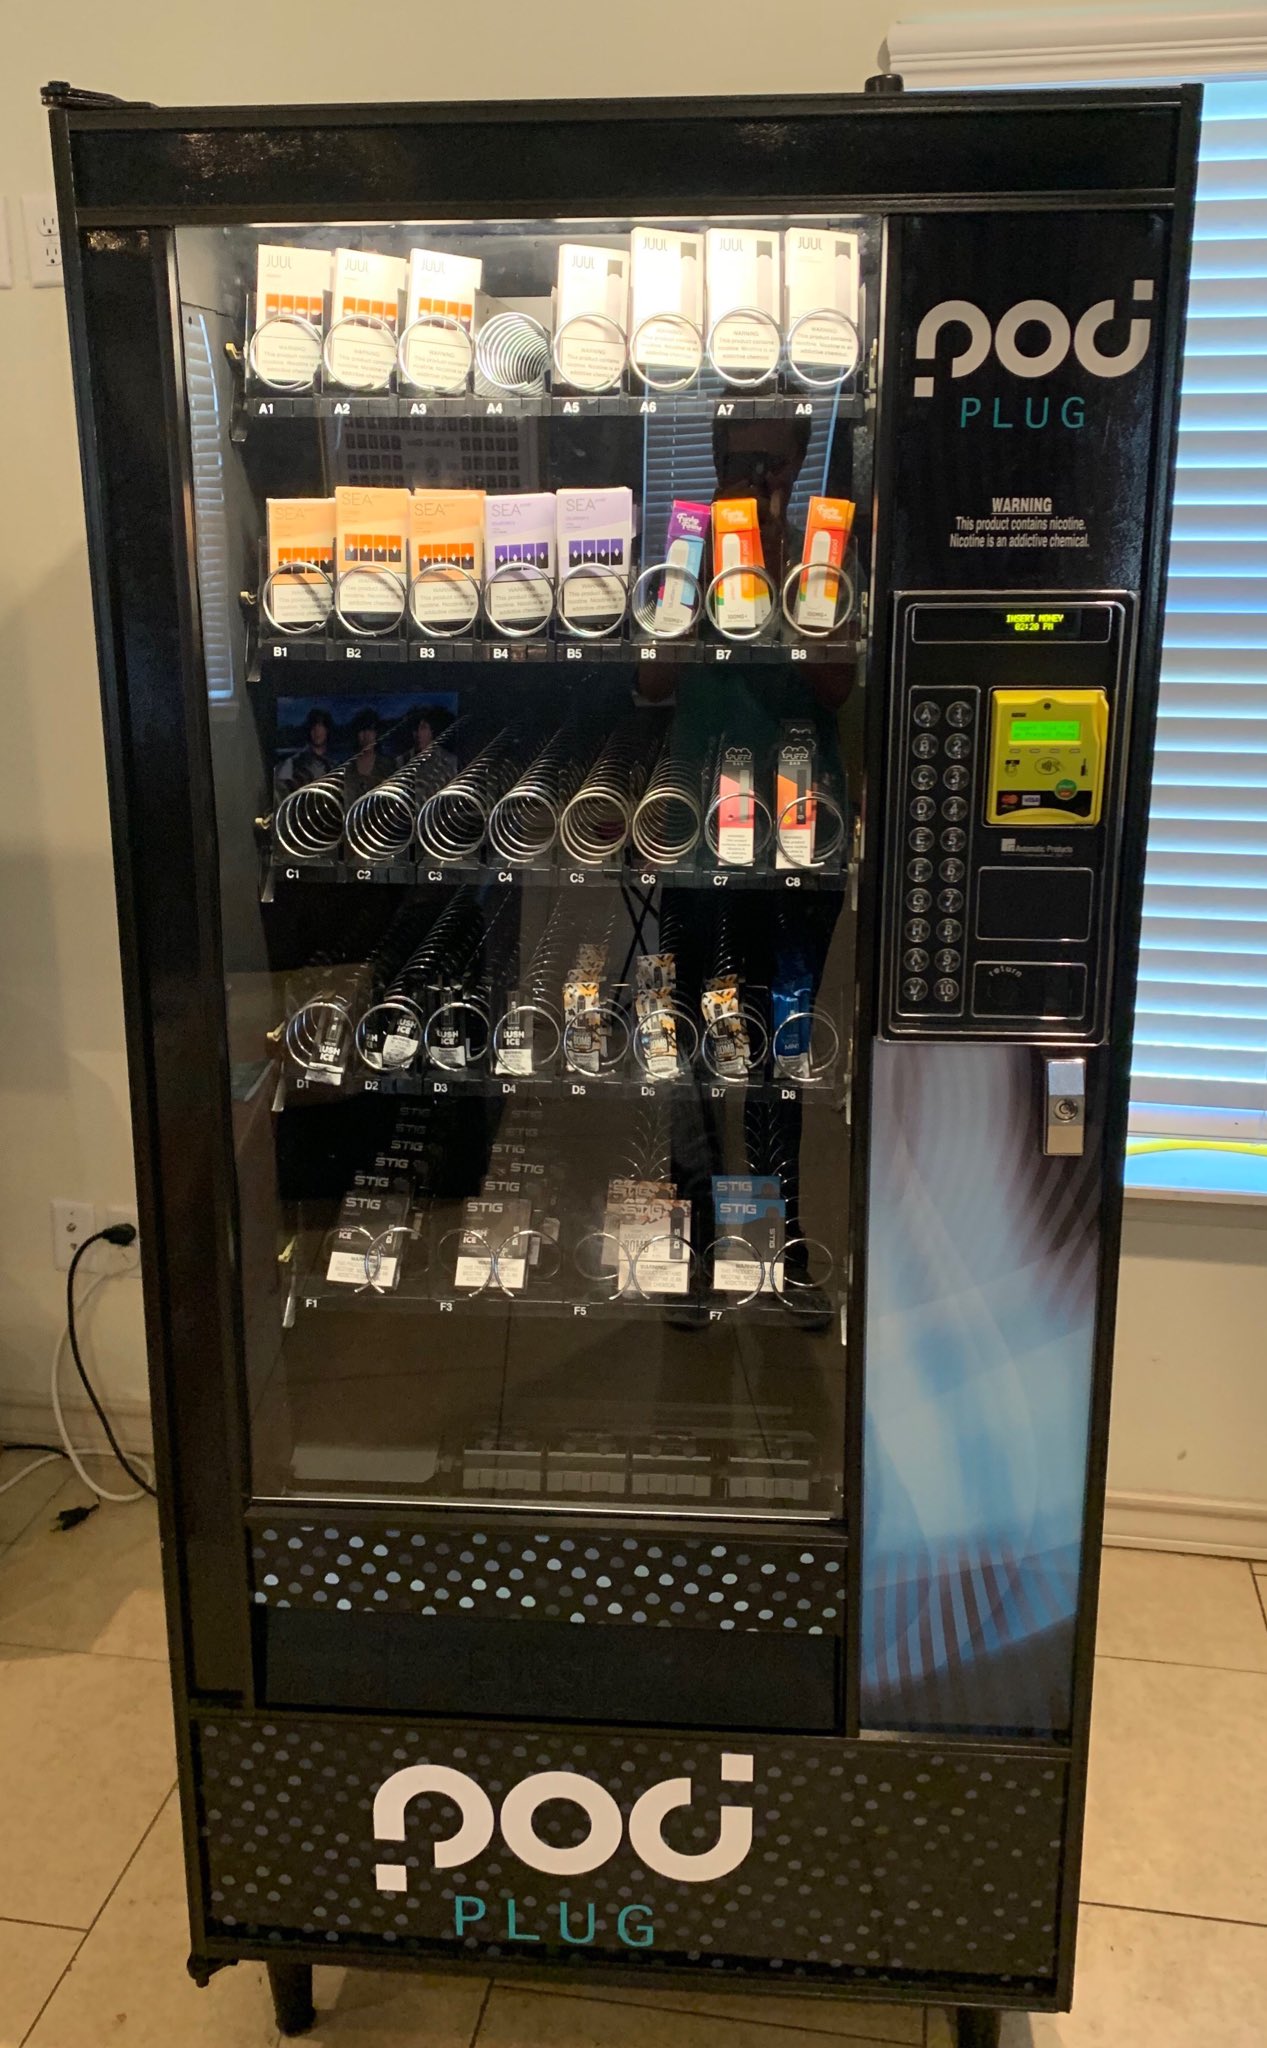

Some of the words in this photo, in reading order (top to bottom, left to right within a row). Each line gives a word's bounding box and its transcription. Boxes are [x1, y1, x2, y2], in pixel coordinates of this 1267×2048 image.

[643, 237, 668, 252] JUUL
[719, 237, 744, 253] JUUL
[797, 236, 822, 251] JUUL
[266, 255, 292, 269] JUUL
[345, 259, 368, 273] JUUL
[421, 259, 446, 274] JUUL
[571, 255, 595, 270] JUUL
[259, 403, 274, 414] A1
[334, 403, 350, 414] A2
[410, 403, 427, 415] A3
[486, 403, 503, 414] A4
[563, 402, 580, 413] A5
[640, 401, 657, 413] A6
[717, 404, 734, 415] A7
[795, 403, 813, 414] A8
[960, 396, 1085, 429] PLUG
[991, 497, 1052, 512] WARNING
[956, 516, 974, 530] This
[976, 516, 1009, 533] product
[1011, 516, 1047, 530] contains
[1049, 516, 1086, 530] nicotine.
[950, 533, 985, 547] Nicotine
[986, 533, 994, 547] is
[996, 536, 1007, 547] an
[1009, 533, 1048, 547] addictive
[1049, 533, 1090, 547] chemical.
[1006, 613, 1035, 622] INSERT
[1038, 613, 1064, 622] MONEY
[1042, 622, 1054, 630] PM
[273, 647, 288, 657] B1
[346, 648, 361, 659] B2
[420, 648, 435, 659] B3
[493, 649, 508, 659] B4
[567, 649, 582, 659] B5
[641, 649, 656, 659] B6
[716, 649, 732, 660] B7
[791, 649, 807, 660] B8
[286, 868, 300, 879] C1
[357, 870, 371, 880] C2
[428, 871, 442, 881] C3
[498, 872, 512, 882] C4
[570, 873, 584, 883] C5
[641, 874, 656, 884] C6
[713, 875, 728, 886] C7
[785, 876, 801, 887] C8
[988, 965, 1023, 978] return
[397, 1025, 411, 1034] ICE
[506, 1038, 520, 1046] ICE
[320, 1053, 334, 1062] ICE
[296, 1079, 310, 1089] D1
[364, 1080, 379, 1091] D2
[433, 1082, 448, 1093] D3
[502, 1084, 516, 1094] D4
[572, 1085, 586, 1095] D5
[641, 1086, 655, 1096] D6
[711, 1088, 726, 1098] D7
[781, 1089, 796, 1100] D8
[391, 1140, 424, 1151] STIG
[492, 1143, 526, 1154] STIG
[375, 1157, 409, 1169] STIG
[510, 1162, 544, 1174] STIG
[354, 1175, 389, 1187] STIG
[484, 1181, 520, 1192] STIG
[716, 1181, 752, 1192] STIG
[345, 1197, 381, 1210] STIG
[467, 1202, 503, 1213] STIG
[720, 1203, 757, 1214] STIG
[338, 1231, 353, 1240] ICE
[306, 1299, 318, 1308] F1
[440, 1302, 453, 1311] F3
[574, 1307, 587, 1316] F5
[709, 1311, 723, 1320] F7
[455, 1895, 655, 1948] PLUG
